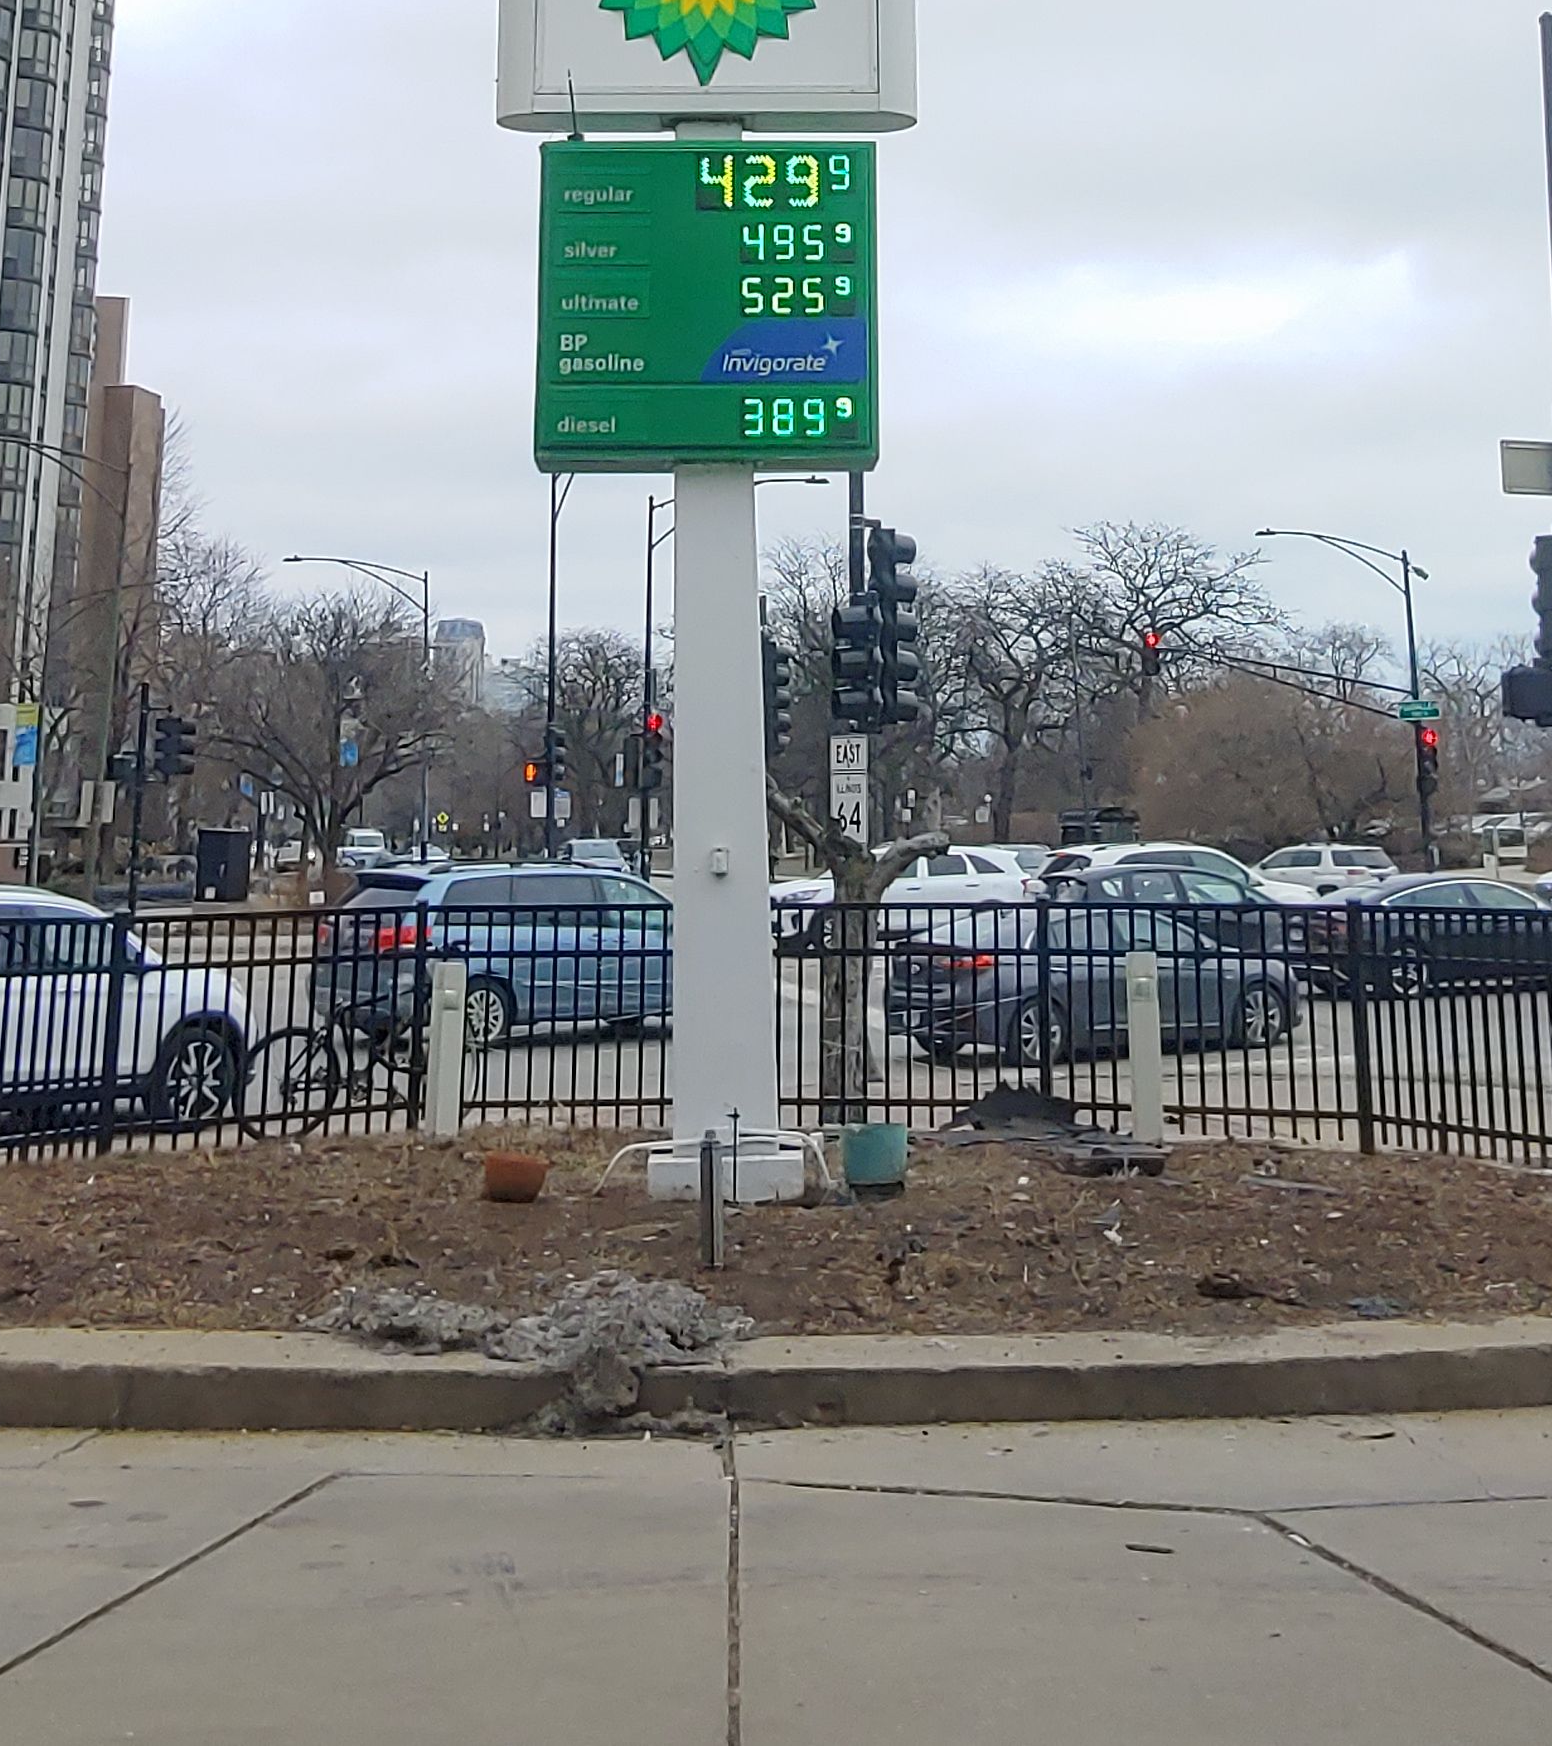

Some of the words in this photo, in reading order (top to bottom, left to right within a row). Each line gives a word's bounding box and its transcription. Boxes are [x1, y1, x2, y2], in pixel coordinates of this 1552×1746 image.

[563, 186, 634, 205] regular
[564, 241, 618, 258] silver
[560, 334, 588, 352] BP
[559, 353, 645, 375] gasoline
[722, 353, 826, 376] Invigorate
[557, 415, 616, 433] diesel
[836, 743, 861, 764] EAST
[838, 801, 861, 834] 64
